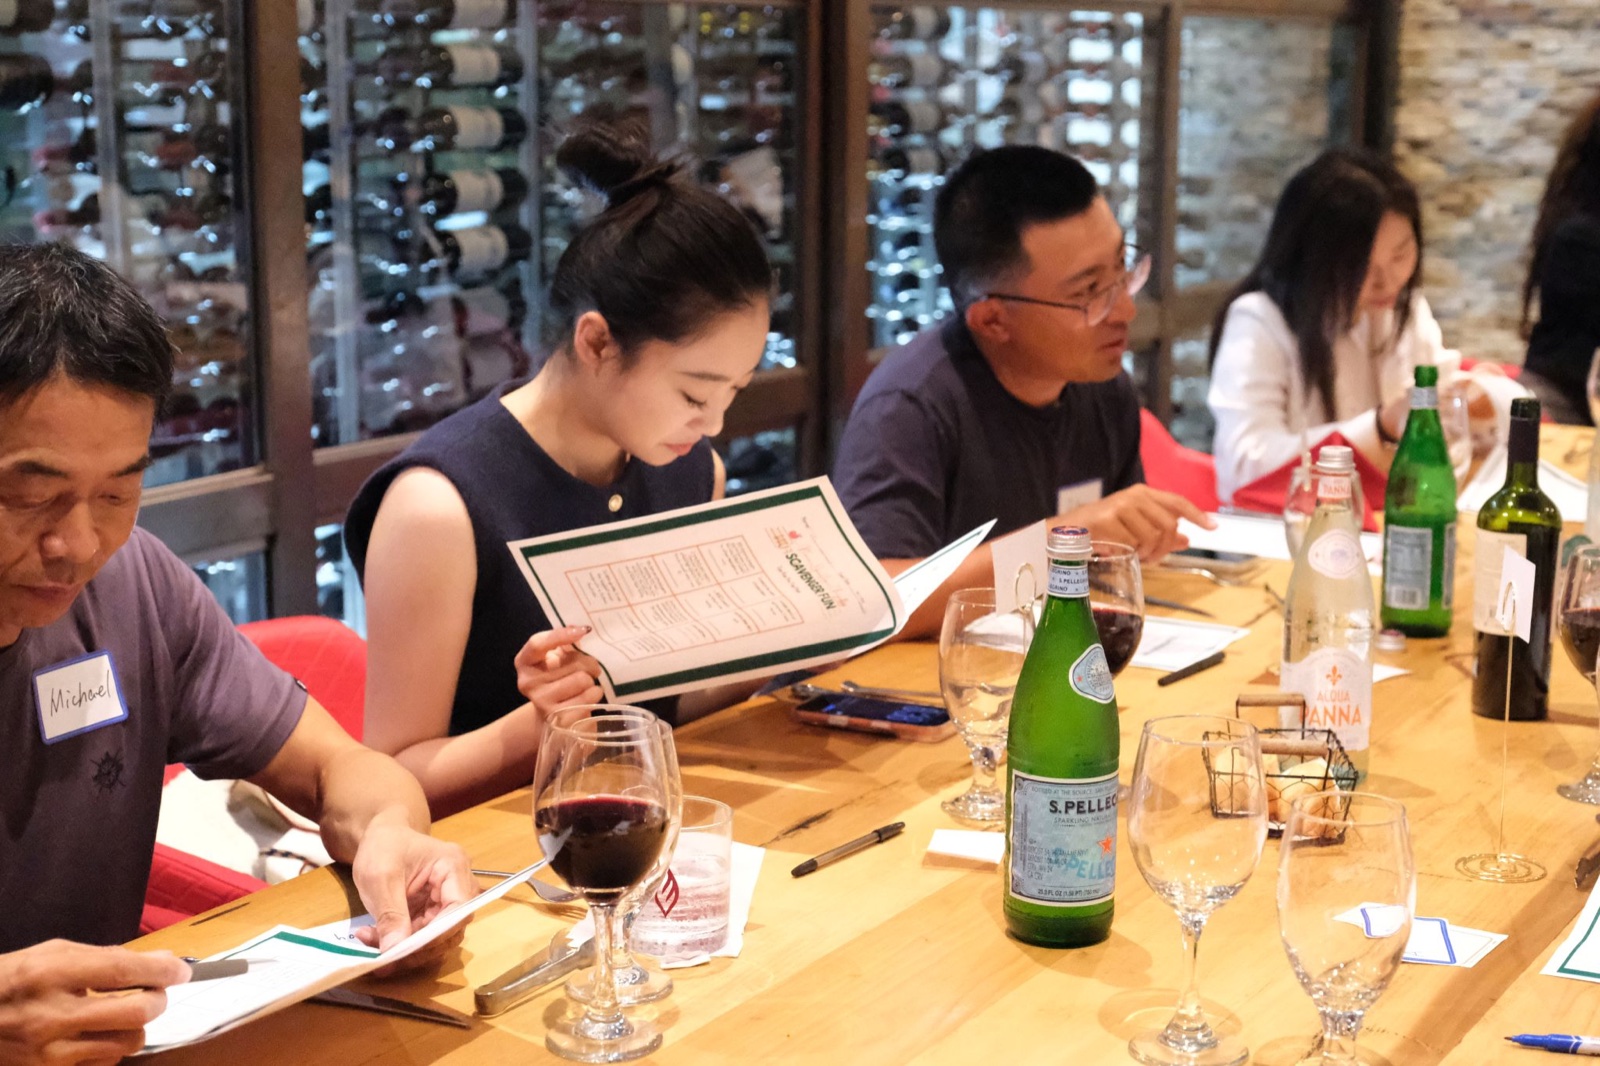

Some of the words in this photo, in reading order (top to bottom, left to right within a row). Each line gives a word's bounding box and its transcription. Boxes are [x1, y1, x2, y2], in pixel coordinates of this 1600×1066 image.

[785, 552, 824, 594] SCAVENGER
[819, 592, 836, 610] FUN
[50, 670, 111, 717] Michael
[1317, 690, 1350, 702] ACQUA
[1299, 703, 1362, 727] PANNA
